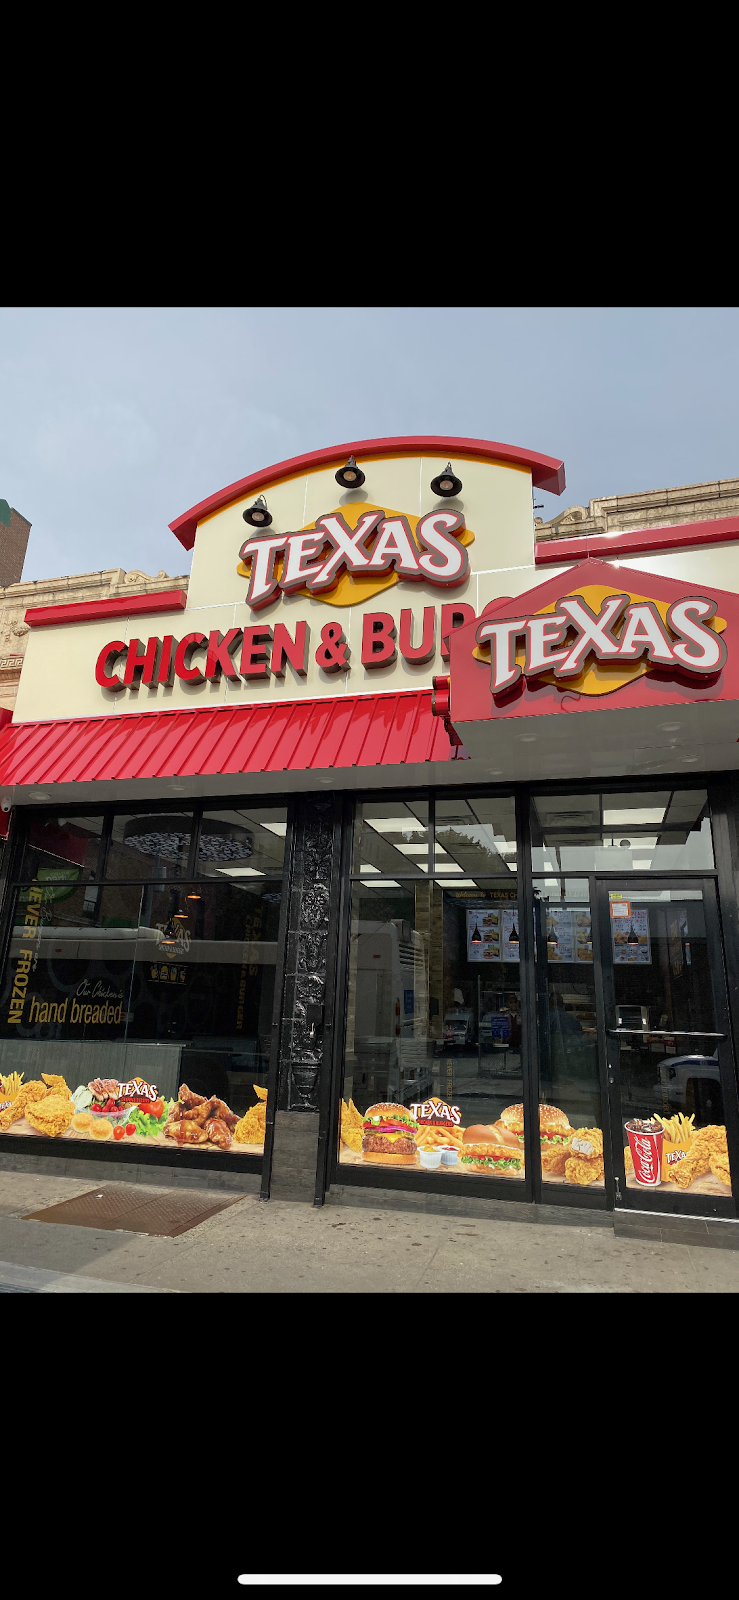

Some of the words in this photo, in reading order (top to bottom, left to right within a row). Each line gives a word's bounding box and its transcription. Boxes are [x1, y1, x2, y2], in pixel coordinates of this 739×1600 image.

[241, 511, 465, 602] TEXAS
[95, 620, 308, 688] CHICKEN
[314, 621, 350, 669] &
[361, 596, 515, 664] BUR
[478, 597, 724, 689] TEXAS
[7, 948, 33, 1024] FROZEN
[76, 979, 90, 997] Our
[28, 995, 69, 1024] hand
[69, 997, 123, 1025] breaded
[117, 1080, 158, 1102] TEXAS
[409, 1100, 461, 1125] TEXAS
[665, 1149, 688, 1164] TEXA
